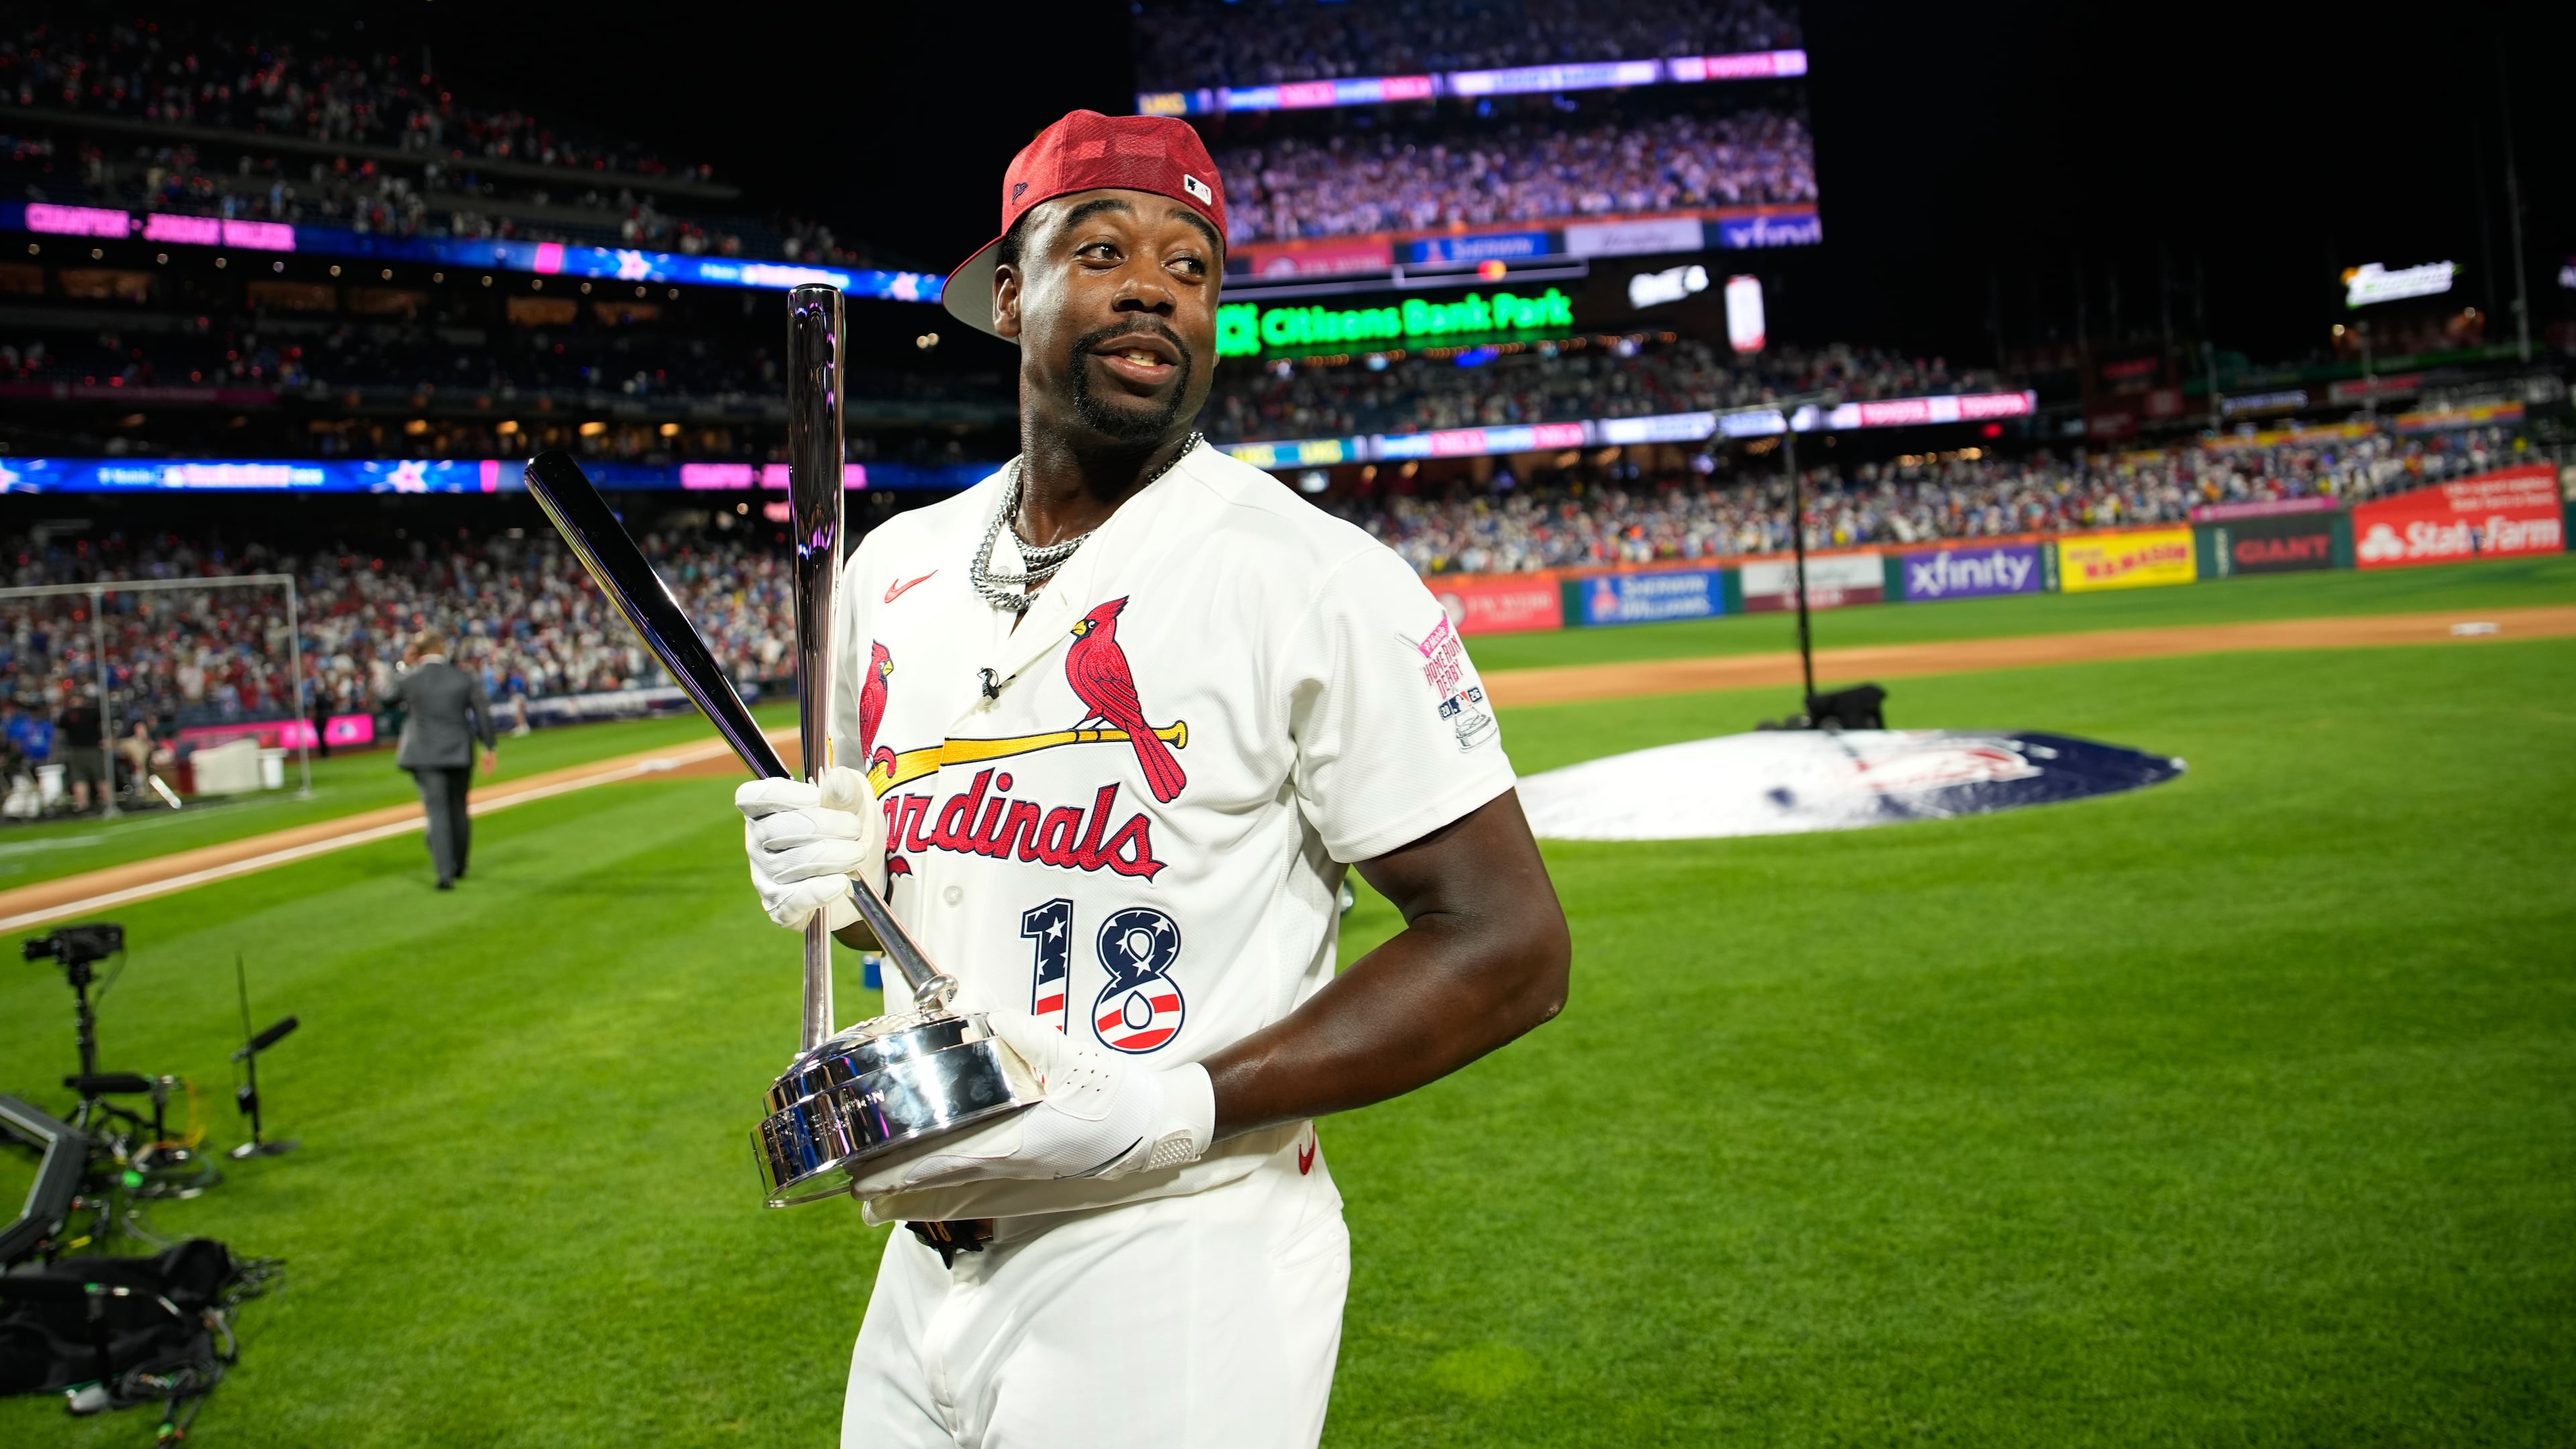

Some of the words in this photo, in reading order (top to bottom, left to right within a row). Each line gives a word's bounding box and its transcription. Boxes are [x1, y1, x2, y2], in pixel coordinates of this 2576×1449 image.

[1261, 307, 1401, 345] Citizens
[1402, 294, 1493, 335] Bank
[1493, 288, 1572, 329] Park
[1911, 550, 2033, 596] xfinity
[2235, 535, 2328, 564] GIANT
[1423, 651, 1448, 686] HOME
[1442, 635, 1461, 664] RUN
[1436, 659, 1463, 699] DERBY
[884, 767, 1167, 883] ardinals
[1020, 898, 1185, 1055] 18
